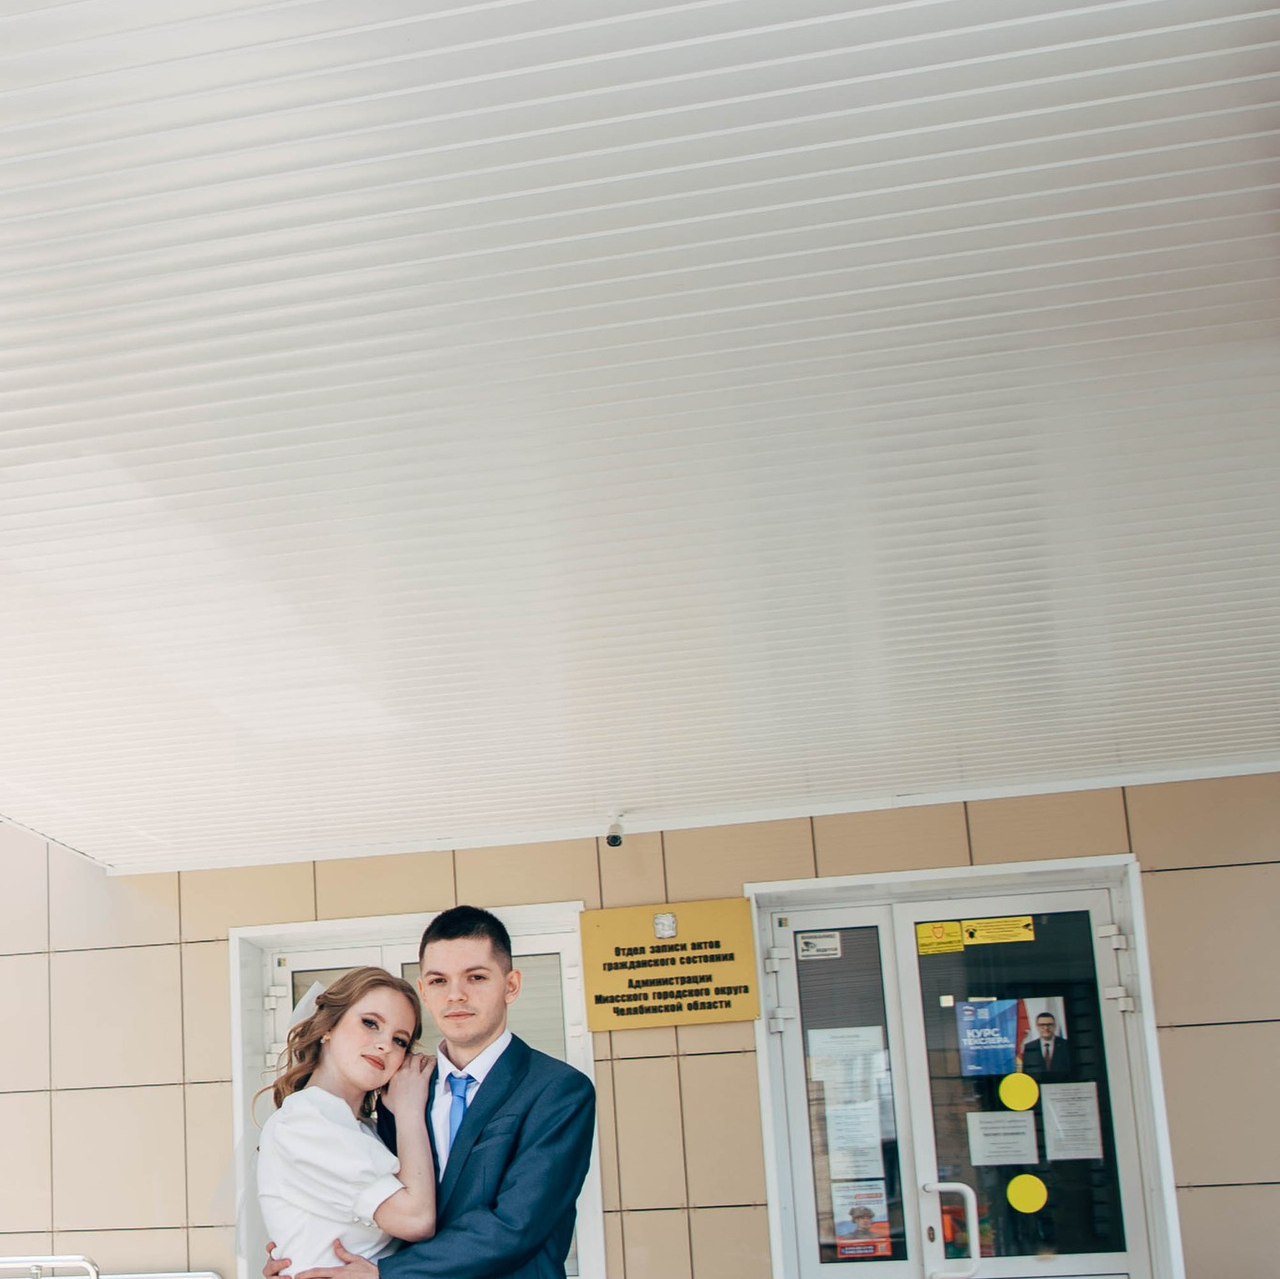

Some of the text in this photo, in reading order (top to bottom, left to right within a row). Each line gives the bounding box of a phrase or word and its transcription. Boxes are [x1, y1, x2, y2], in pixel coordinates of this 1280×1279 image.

[614, 940, 721, 957] Отдел записи актов
[602, 952, 735, 971] гражданского состояния
[628, 974, 712, 989] Администрации
[594, 985, 749, 1004] Миасского городского округа
[613, 999, 732, 1016] Челябинской области
[966, 1028, 1000, 1038] КУРС
